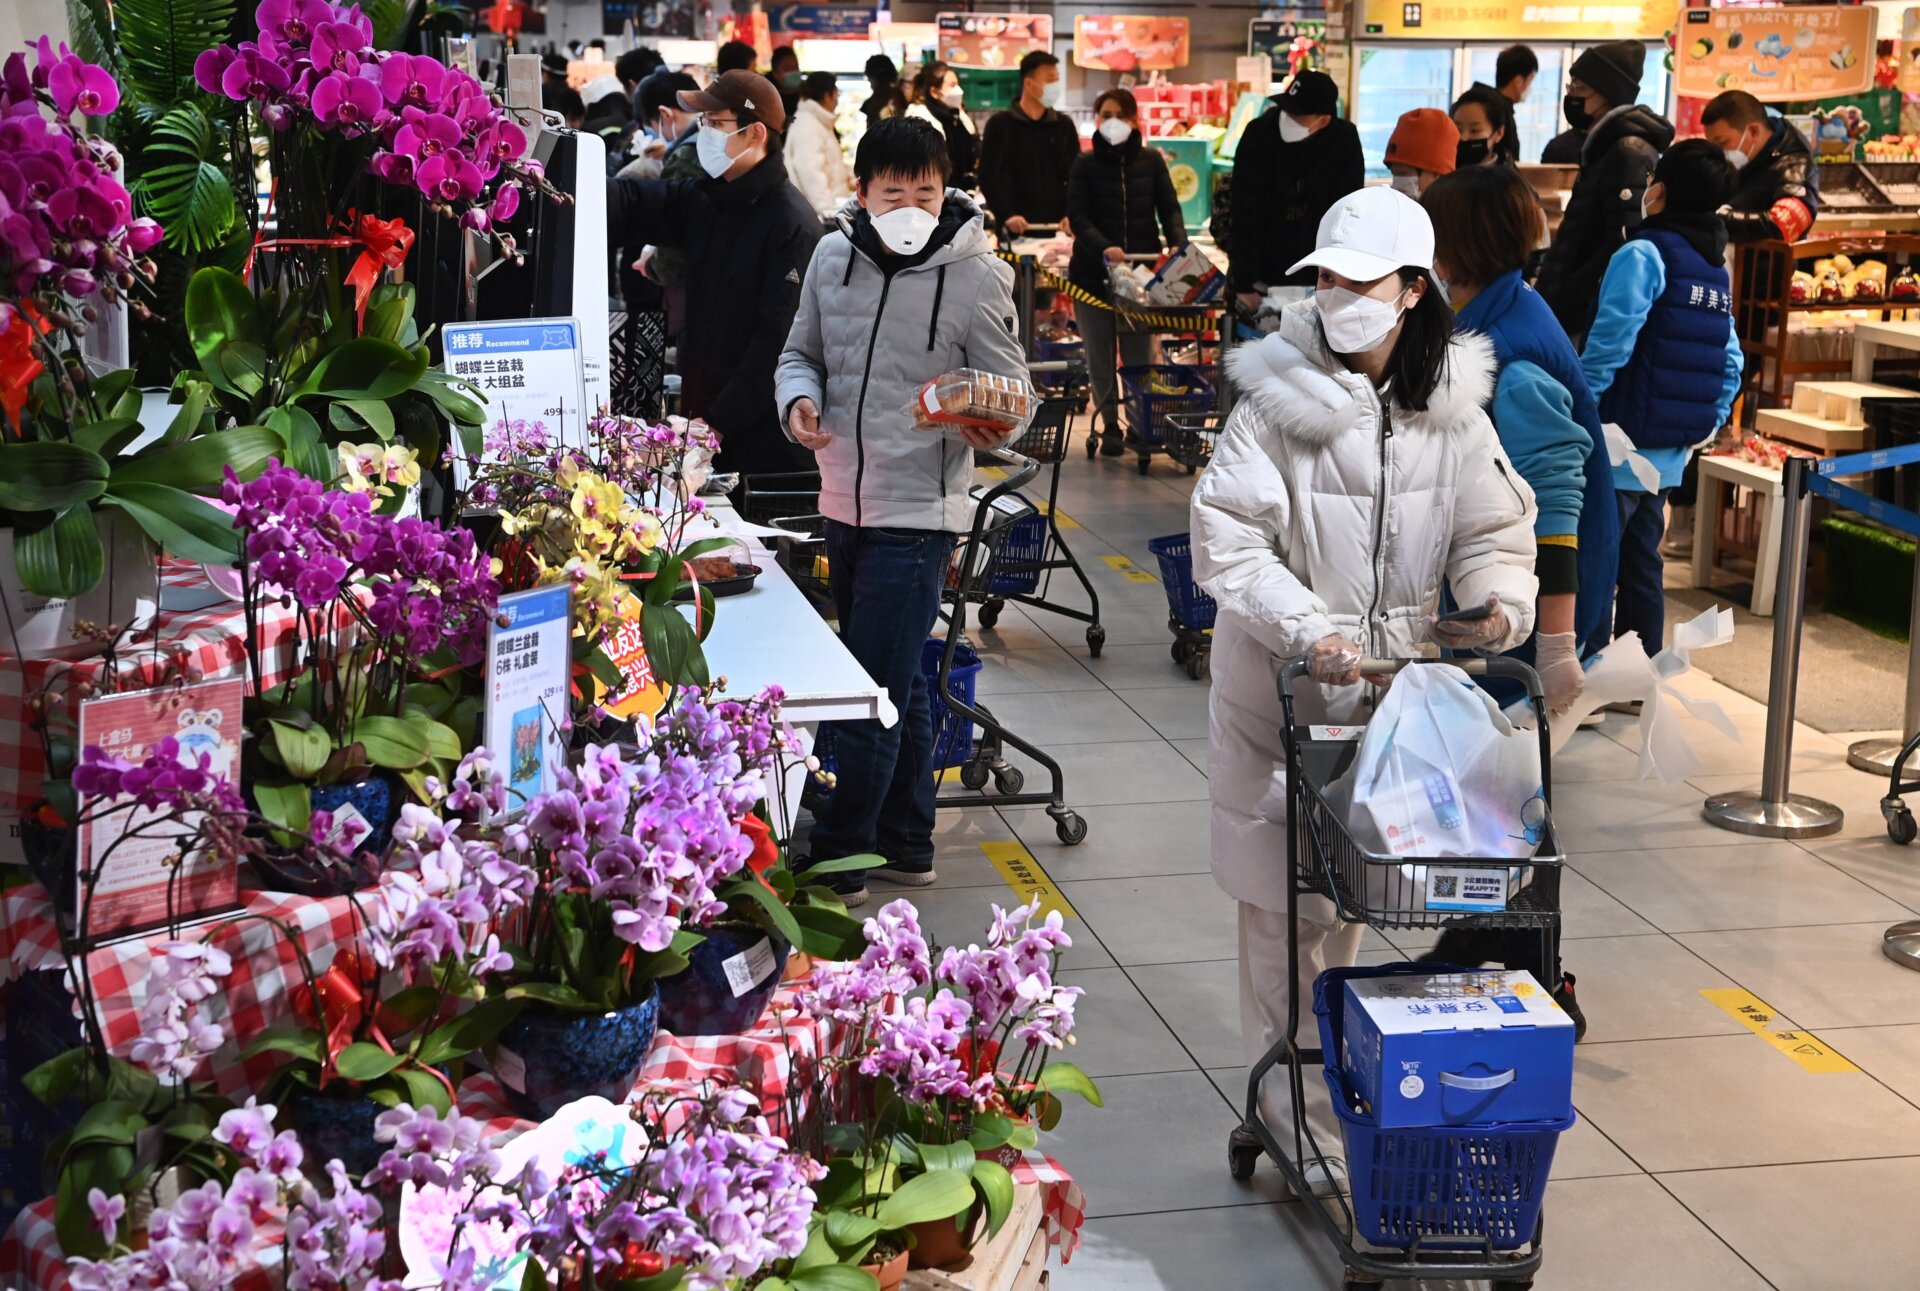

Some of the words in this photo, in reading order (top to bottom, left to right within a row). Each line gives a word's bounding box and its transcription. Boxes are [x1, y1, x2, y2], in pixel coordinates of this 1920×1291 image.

[1744, 12, 1790, 25] PARTY
[452, 332, 484, 349] 推荐
[485, 338, 530, 348] Recommend
[455, 358, 524, 375] 蝴蝶兰盆栽
[484, 374, 526, 389] 大组盆
[496, 631, 540, 656] 蝴蝶兰盆栽
[496, 657, 512, 676] 6株
[513, 650, 539, 671] 礼盒装
[1463, 885, 1500, 893] 手机APP下单
[1464, 877, 1501, 885] 3公里范围内
